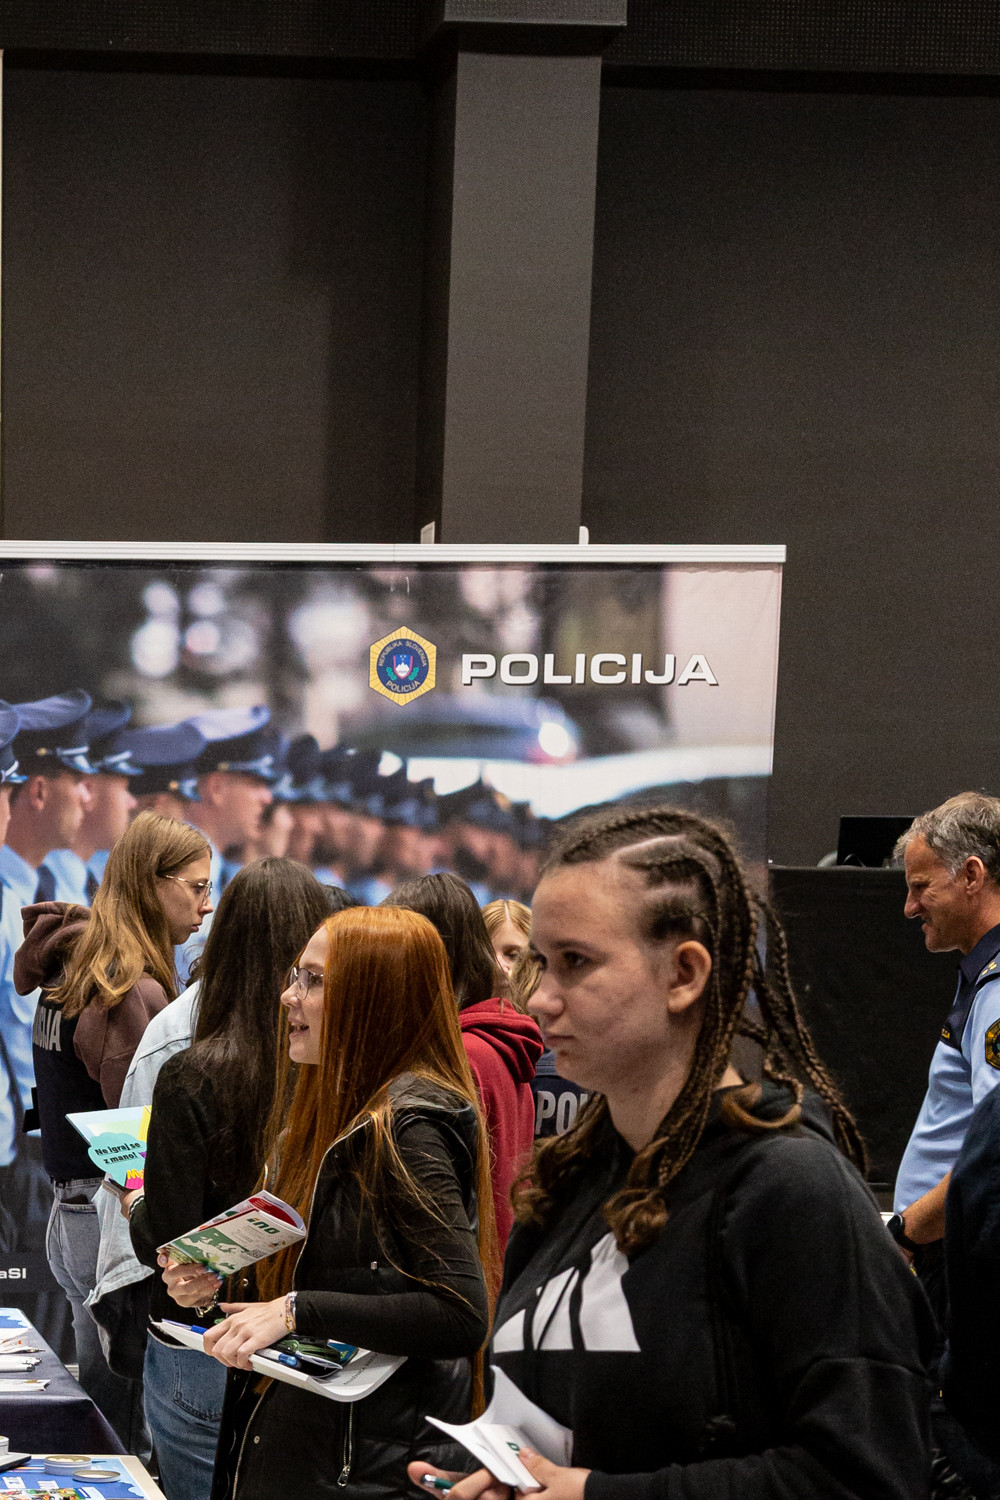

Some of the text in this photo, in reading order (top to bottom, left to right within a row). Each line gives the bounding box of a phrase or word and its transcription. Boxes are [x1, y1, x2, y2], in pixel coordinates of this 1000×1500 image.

[461, 653, 719, 686] POLICIJA
[386, 680, 420, 692] POLICIJA
[94, 1148, 109, 1156] Ne
[107, 1142, 131, 1154] igraj
[109, 1151, 138, 1163] mano!
[246, 1217, 281, 1235] ino
